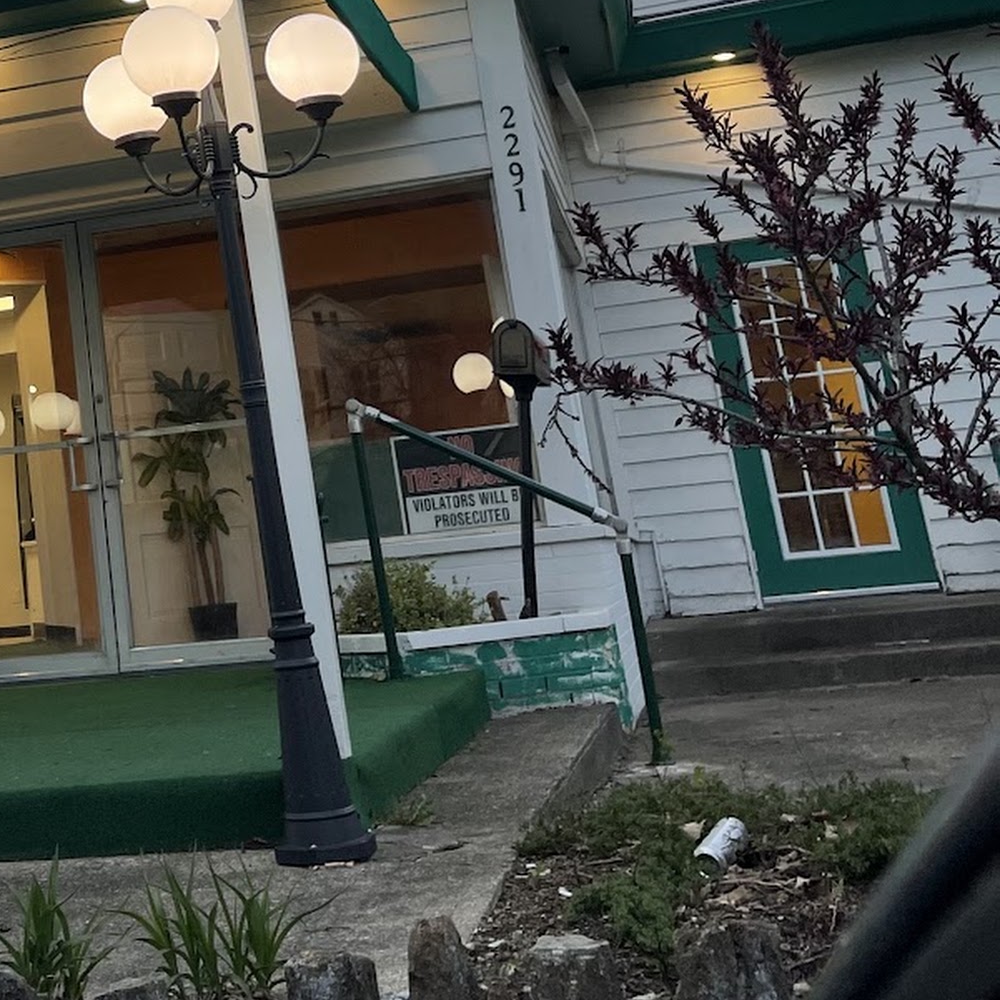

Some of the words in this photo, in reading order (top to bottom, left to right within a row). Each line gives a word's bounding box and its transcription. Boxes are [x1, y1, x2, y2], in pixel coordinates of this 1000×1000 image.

[500, 105, 526, 212] 2291
[402, 456, 521, 493] TRESPASSG
[412, 491, 476, 513] VIOLATORS
[477, 489, 509, 506] WILL
[435, 508, 510, 528] PROSECUTED
